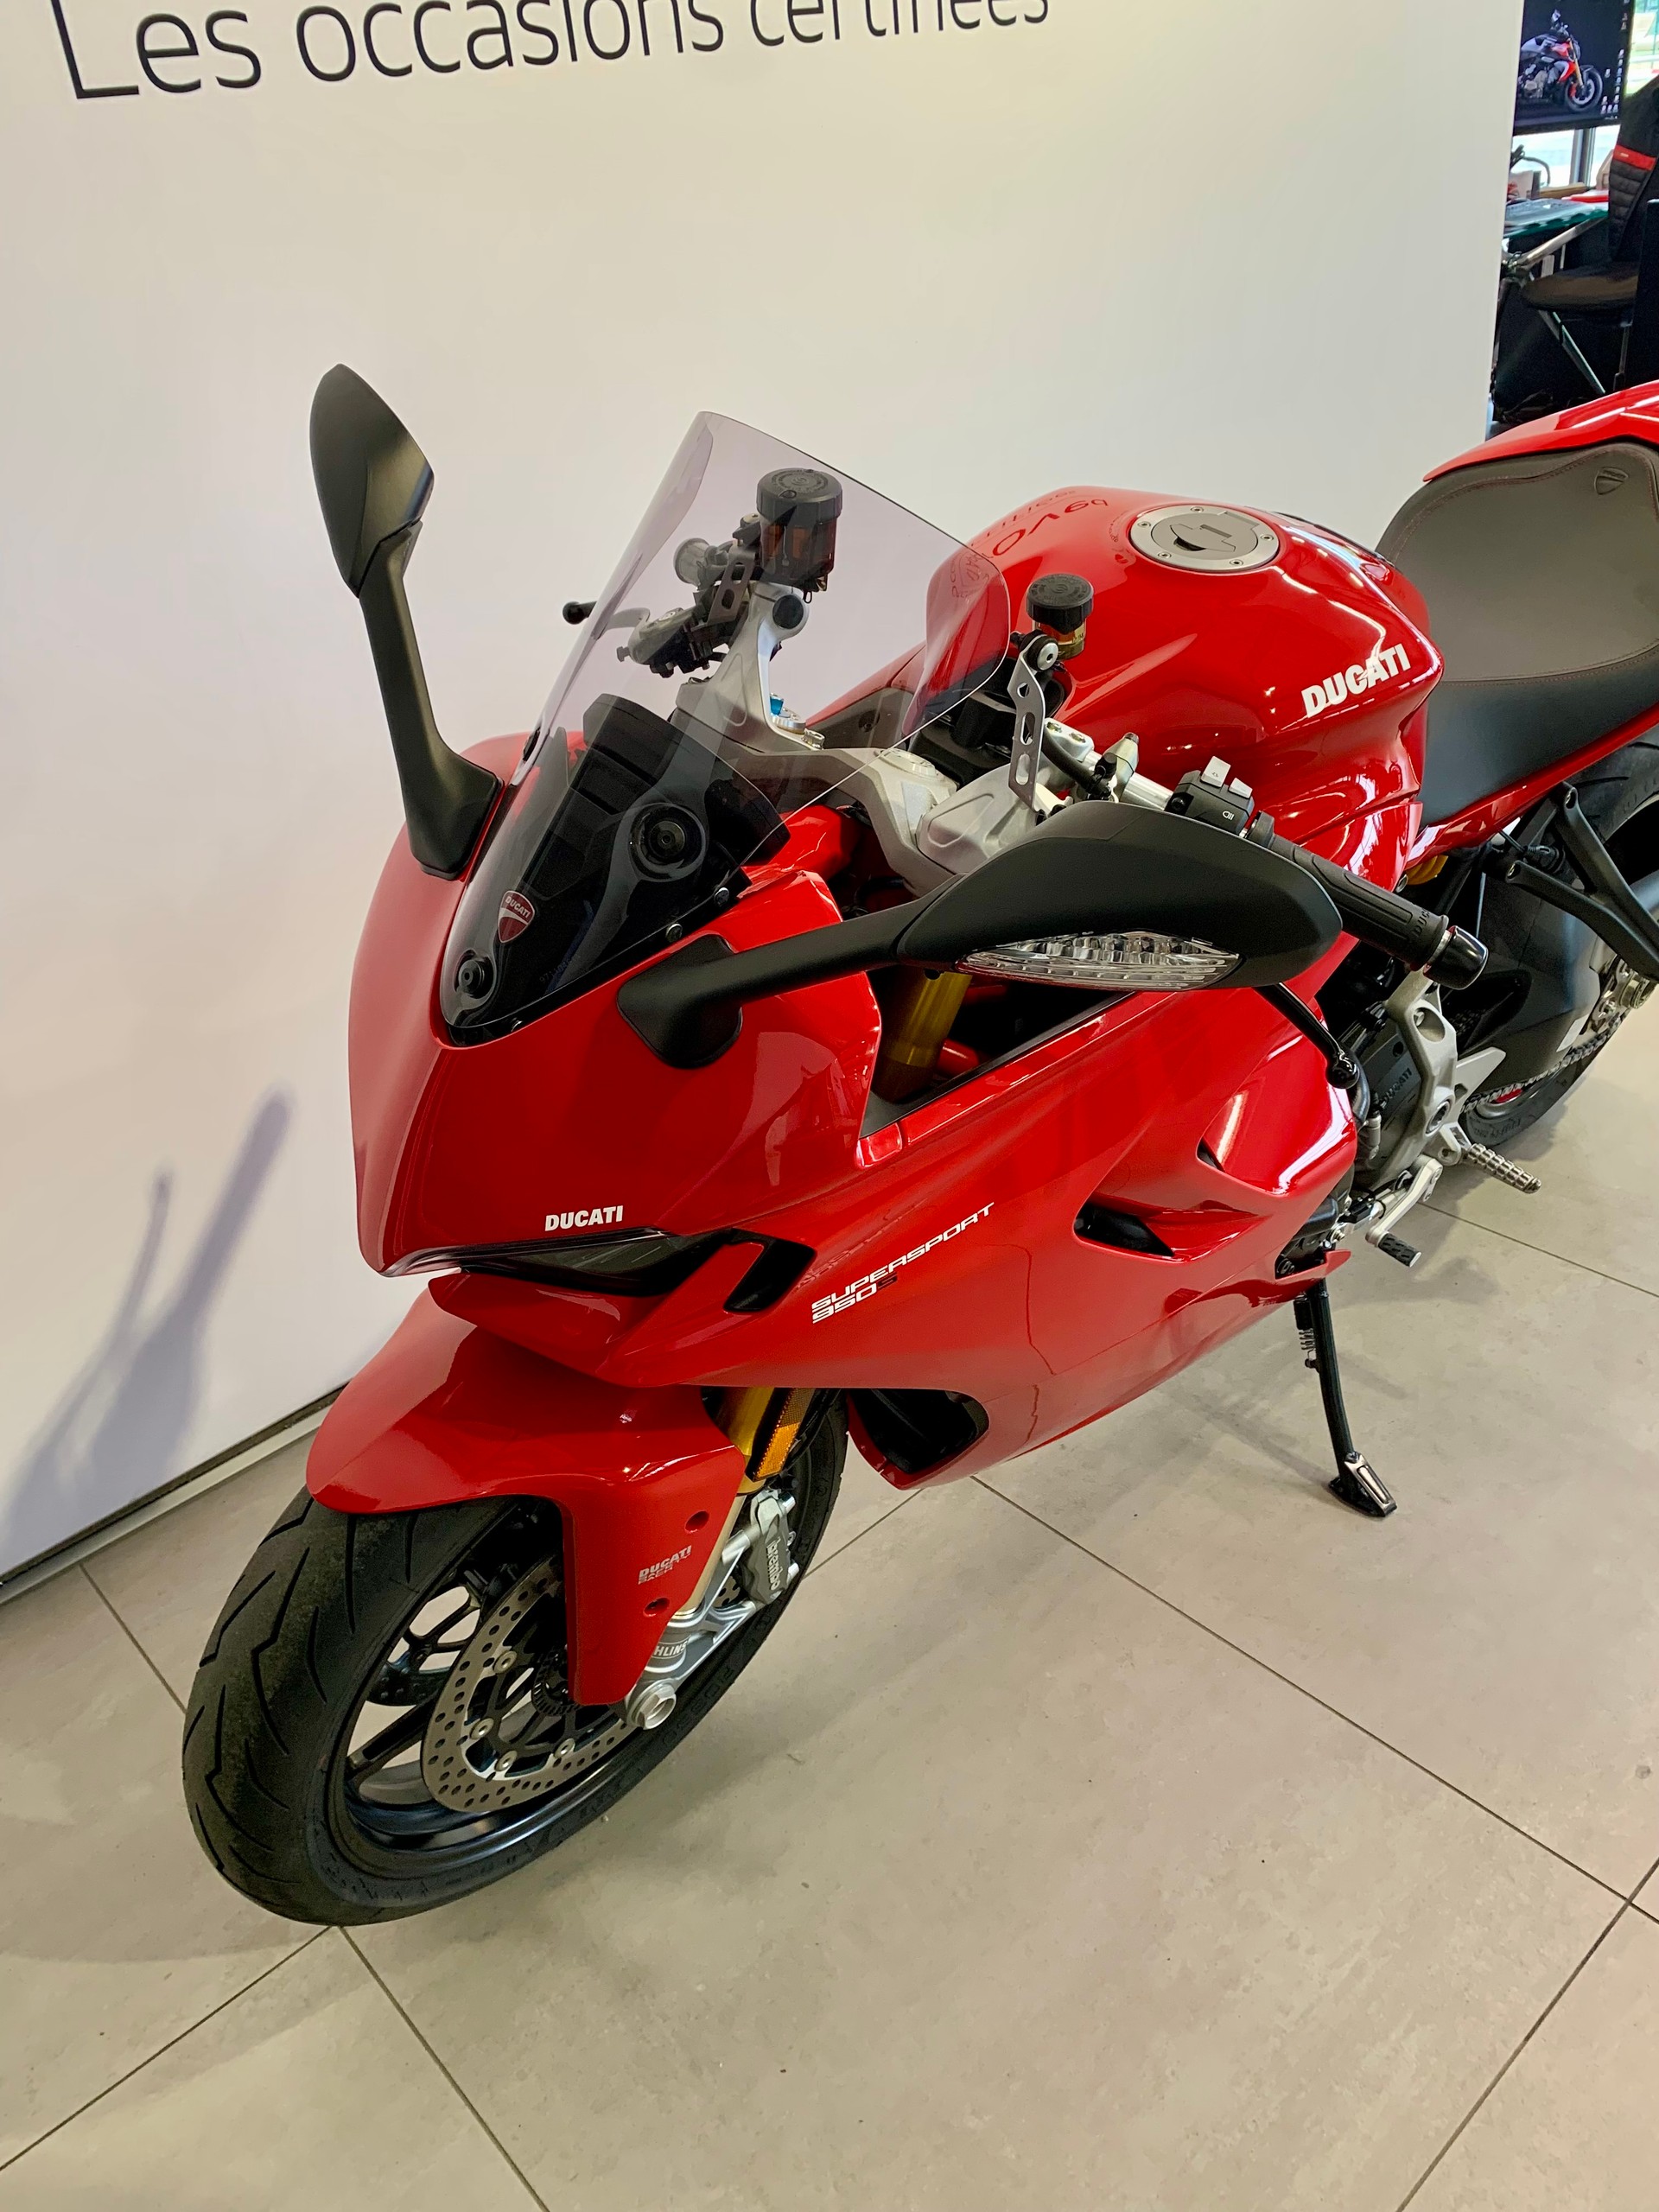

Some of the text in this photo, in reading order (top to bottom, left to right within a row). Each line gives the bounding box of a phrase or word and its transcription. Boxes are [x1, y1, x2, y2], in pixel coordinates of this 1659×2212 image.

[51, 0, 261, 99] Les
[296, 0, 724, 82] occasions
[1301, 643, 1411, 718] DUCATI
[505, 896, 531, 918] DUCATI
[544, 1205, 624, 1231] DUCATI
[811, 1202, 995, 1313] SUPERSPORT
[639, 1545, 692, 1579] DUCATI
[766, 1536, 784, 1591] brembo
[653, 1640, 688, 1656] HLINS
